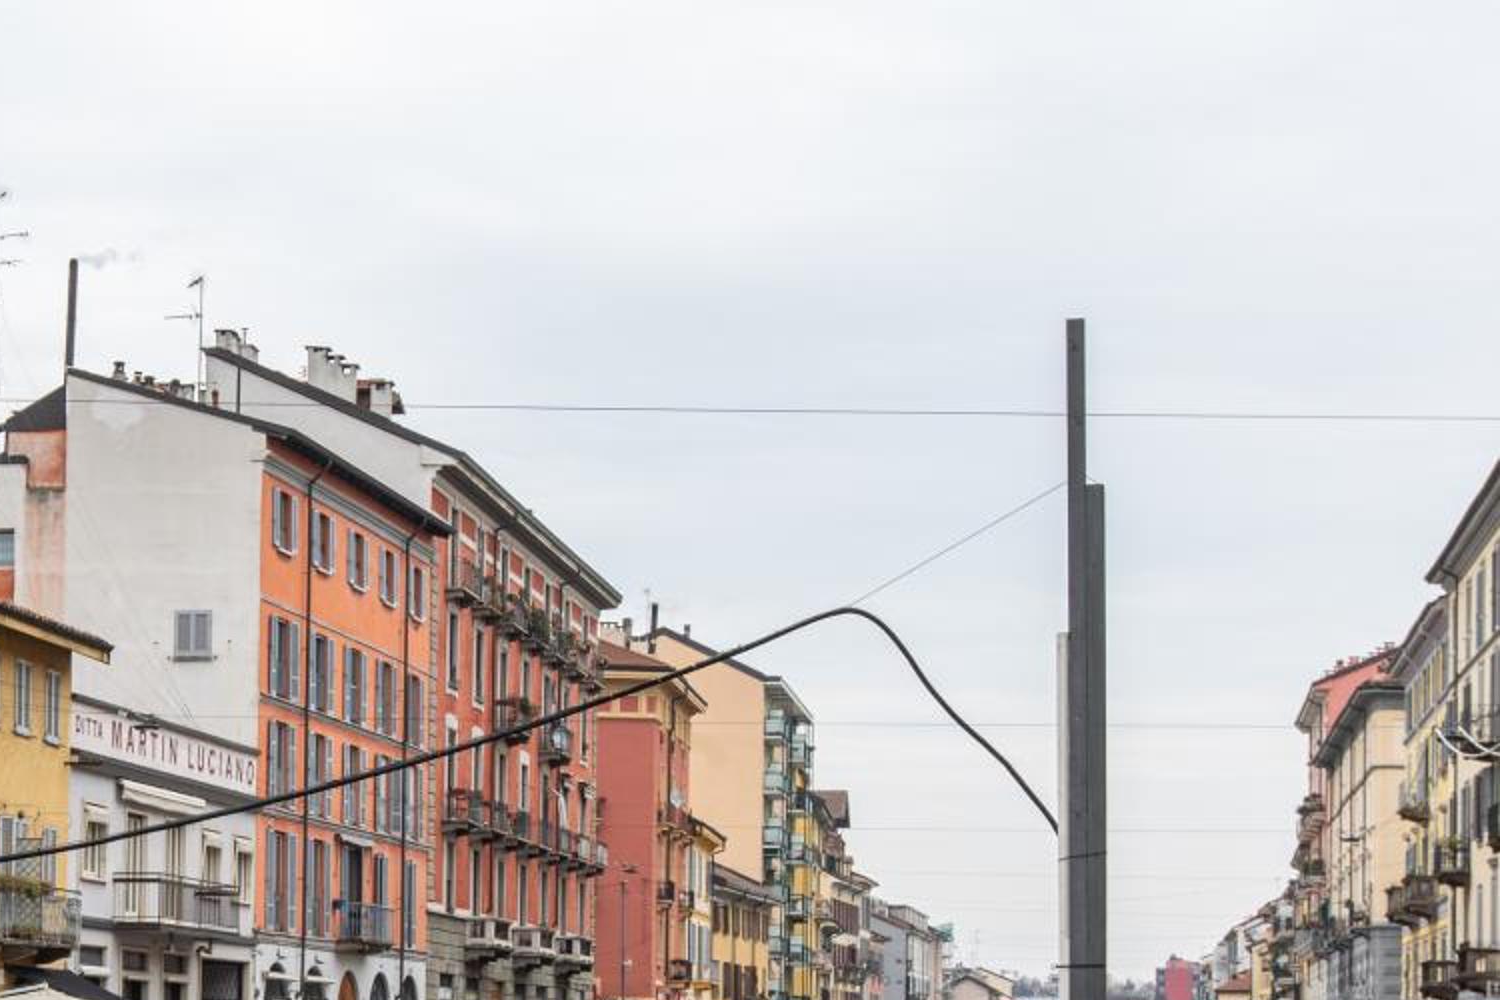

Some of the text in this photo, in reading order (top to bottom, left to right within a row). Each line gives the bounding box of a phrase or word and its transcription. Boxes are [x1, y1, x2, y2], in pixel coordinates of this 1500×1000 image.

[75, 714, 255, 785] DITTA MARTIN LUCIANO
